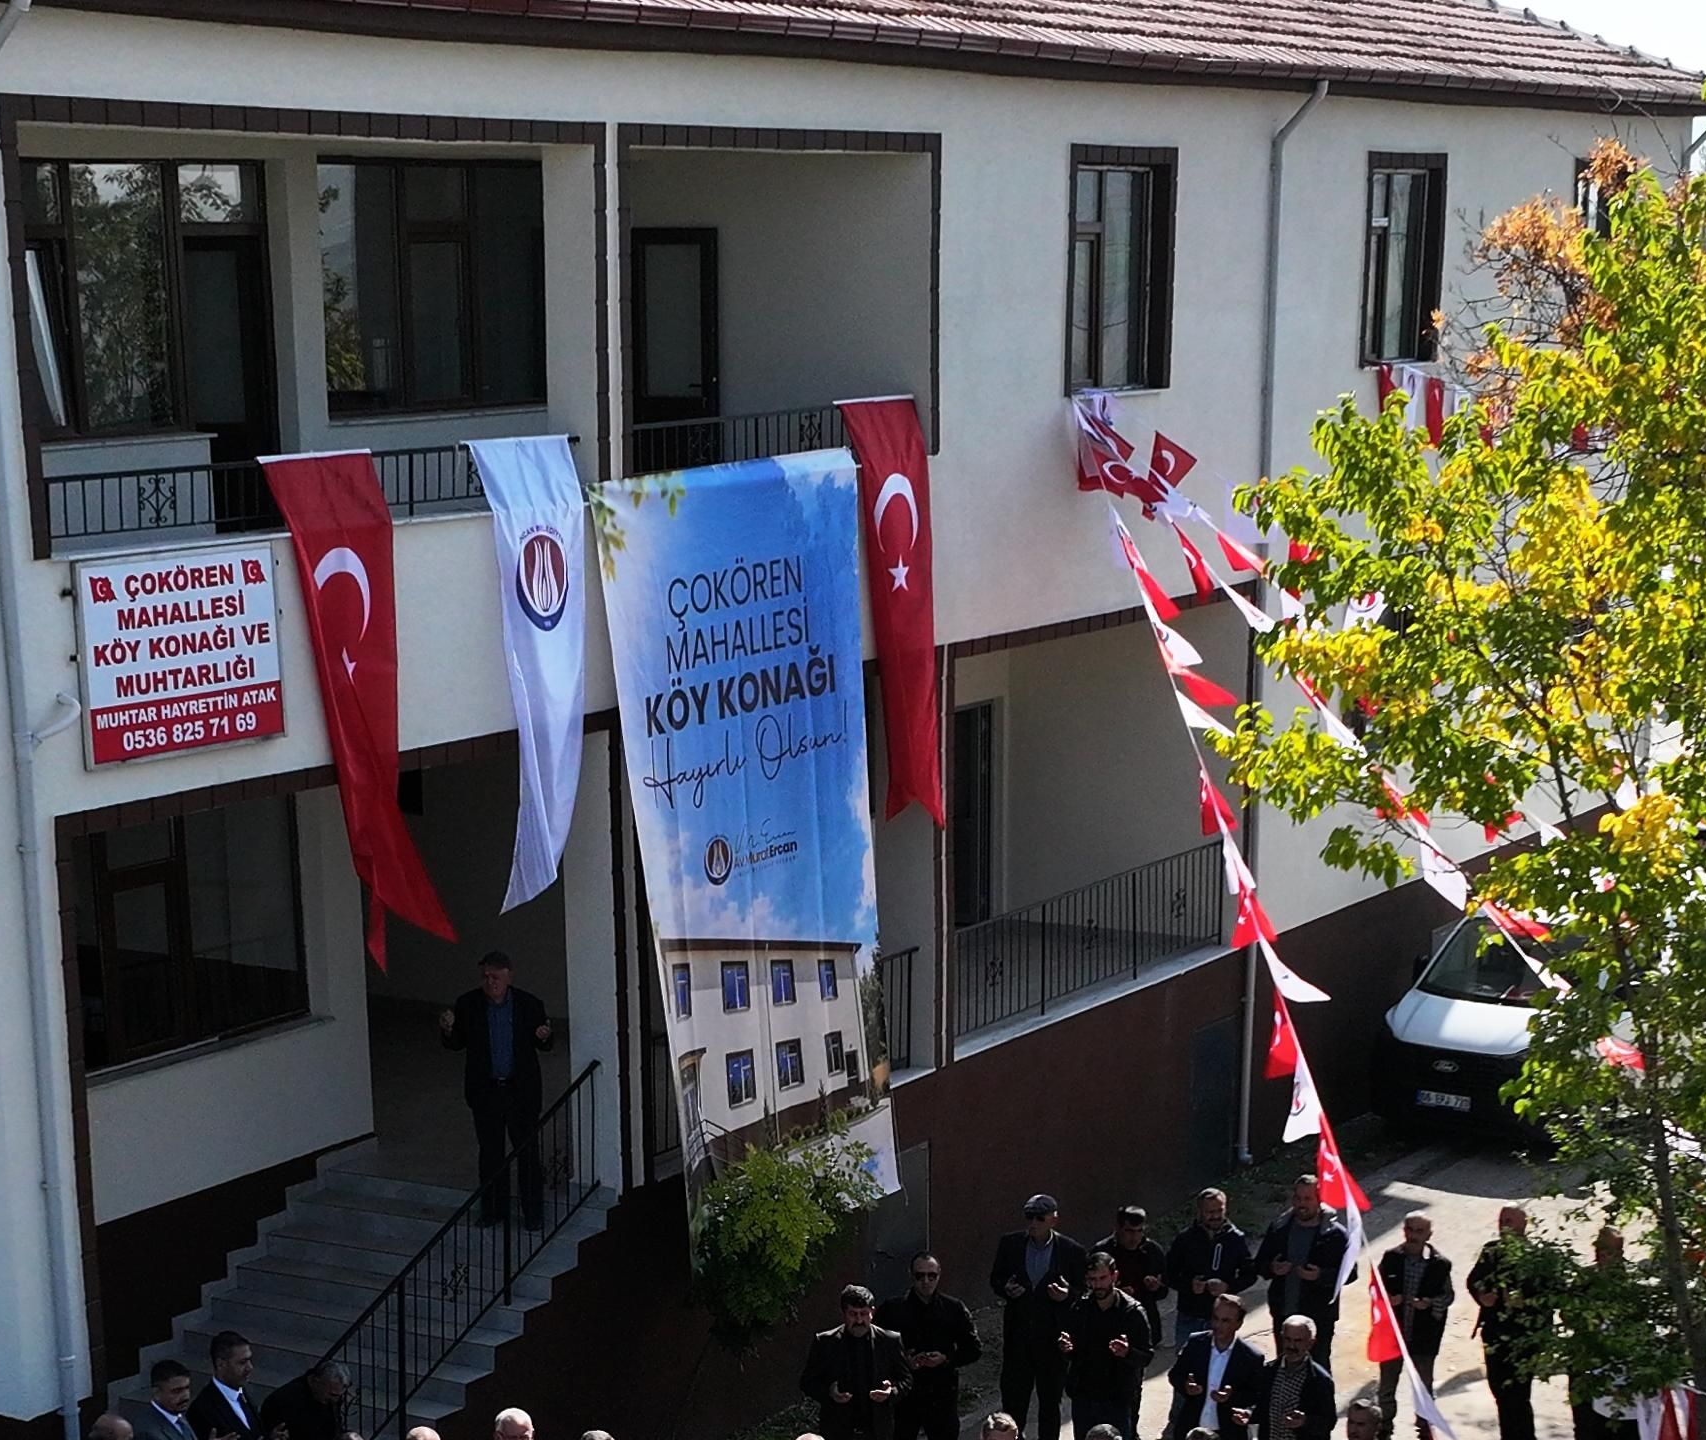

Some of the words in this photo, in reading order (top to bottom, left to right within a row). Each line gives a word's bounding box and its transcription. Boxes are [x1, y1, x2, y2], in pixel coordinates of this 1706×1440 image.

[124, 563, 234, 602] ÇOKÖREN
[668, 554, 802, 632] ÇOKÖREN
[117, 589, 245, 631] MAHALLESİ
[93, 637, 141, 667] KÖY
[149, 624, 235, 659] KONAĞI
[241, 622, 271, 646] VE
[665, 596, 810, 674] MAHALLESİ
[115, 654, 256, 698] MUHTARLIĞI
[645, 676, 707, 739] KÖY
[717, 645, 835, 720] KONAĞI
[96, 706, 157, 730] MUHTAR
[160, 694, 238, 720] HAYRETTİN
[241, 686, 277, 705] ATAK
[122, 727, 168, 751] 0536
[173, 721, 205, 743] 825
[209, 717, 230, 738] 71
[235, 711, 257, 732] 69
[643, 730, 747, 810] Hayırlı
[755, 700, 849, 783] Olsun!
